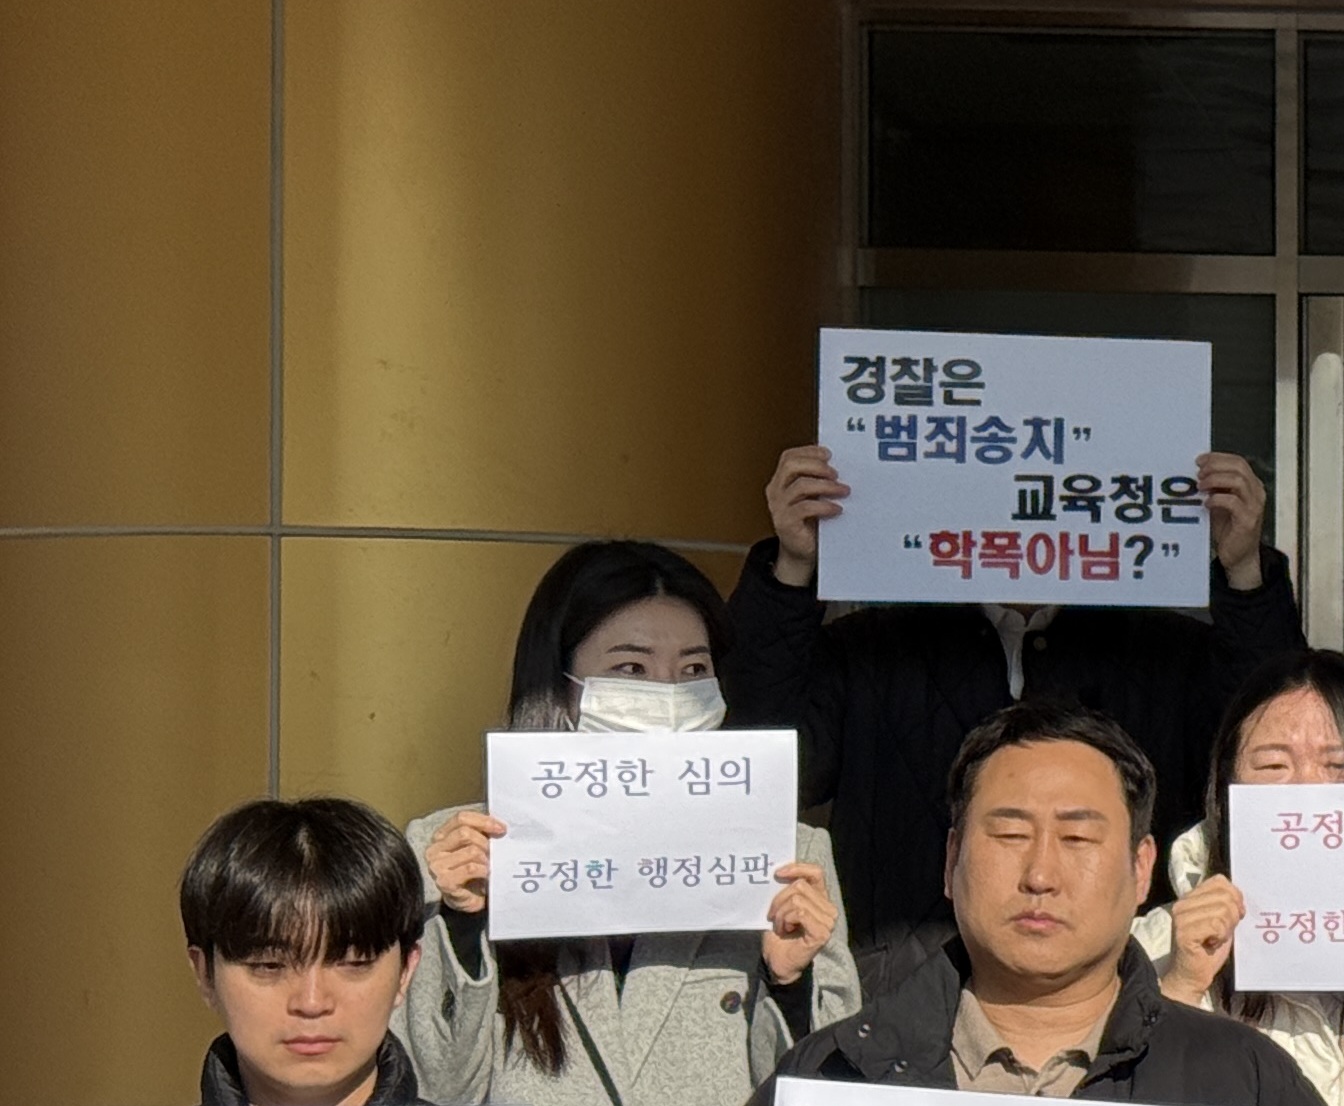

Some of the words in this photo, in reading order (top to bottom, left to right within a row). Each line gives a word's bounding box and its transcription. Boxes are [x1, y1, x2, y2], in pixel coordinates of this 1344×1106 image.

[841, 356, 985, 406] 경찰은
[847, 415, 1090, 463] “범죄송치”
[1012, 474, 1203, 523] 교육청은
[531, 758, 654, 799] 공정한
[679, 757, 751, 795] 심의
[513, 859, 617, 893] 공정한
[638, 853, 773, 888] 행정심판
